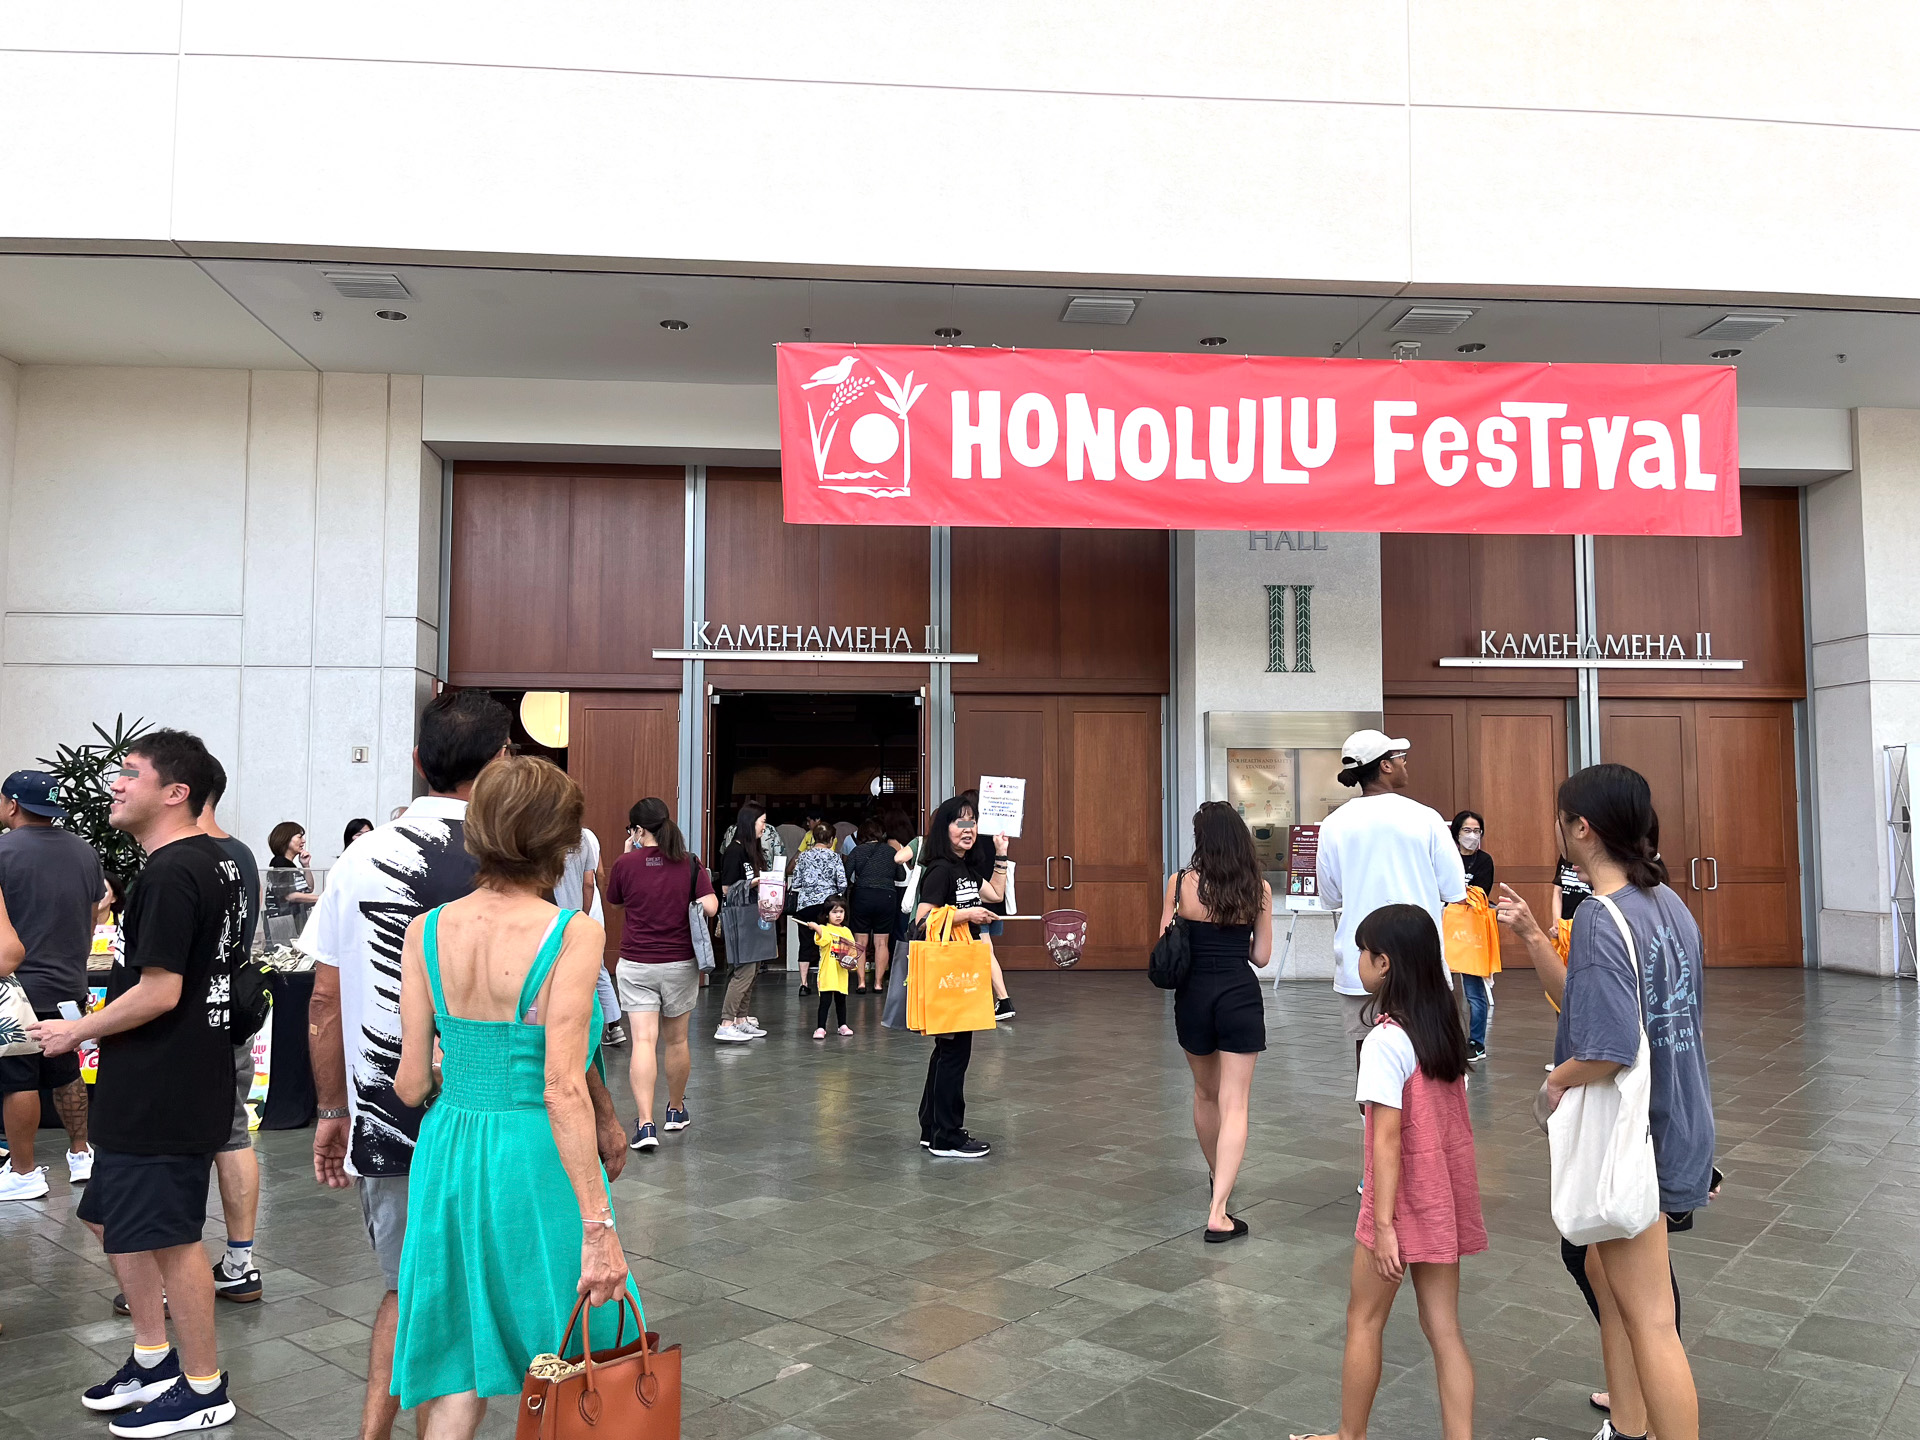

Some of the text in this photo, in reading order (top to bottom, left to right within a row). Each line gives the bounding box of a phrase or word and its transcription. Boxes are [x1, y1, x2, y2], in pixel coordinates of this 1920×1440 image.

[951, 390, 1337, 484] HONOLULU
[1249, 531, 1329, 551] HALL
[692, 620, 940, 649] KAMEHAMEHA II
[1480, 630, 1711, 656] KAMEHAMEHA II
